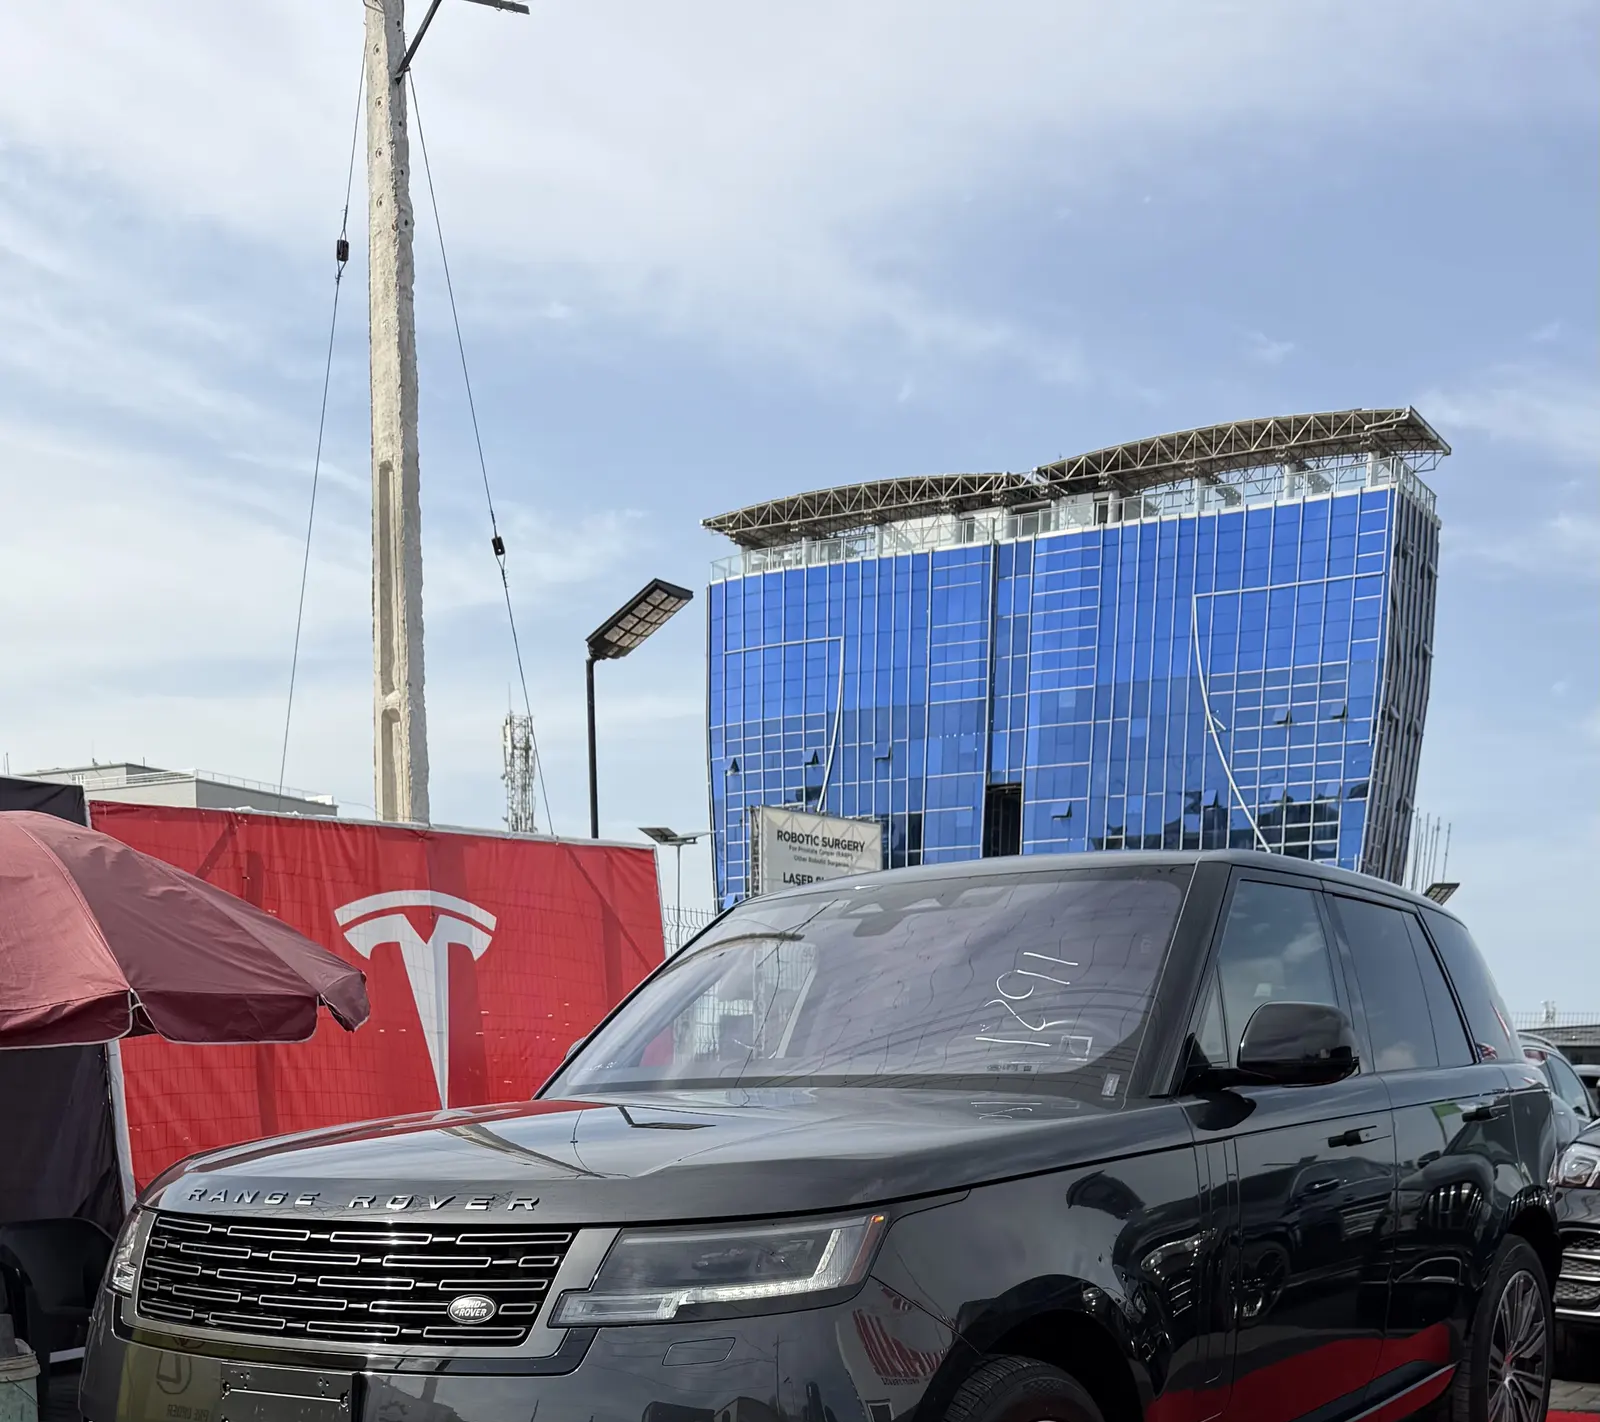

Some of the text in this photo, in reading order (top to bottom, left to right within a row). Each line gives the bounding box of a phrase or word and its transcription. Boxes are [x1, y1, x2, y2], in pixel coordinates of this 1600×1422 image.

[777, 830, 865, 852] ROBOTIC SURGERY
[188, 1188, 541, 1211] RANGE ROVER
[458, 1308, 487, 1317] ROVER
